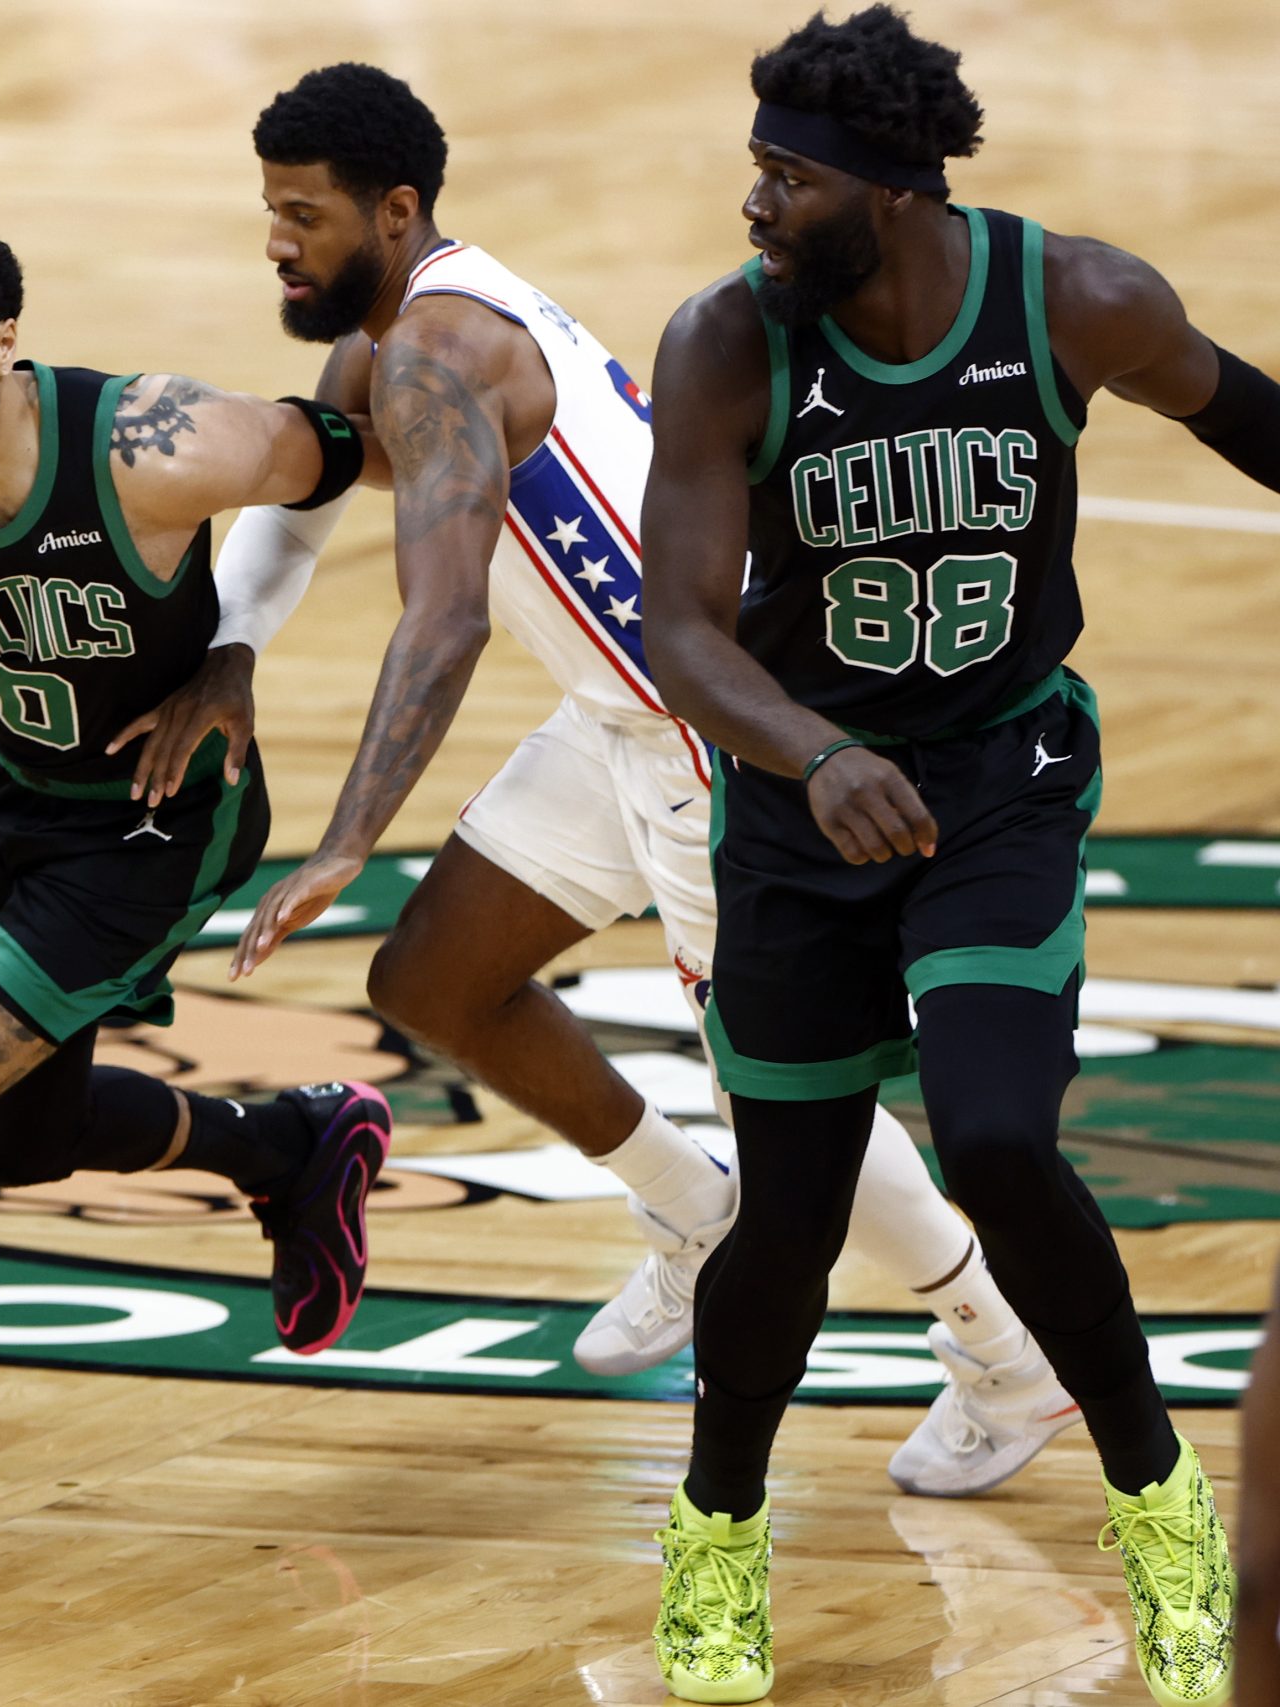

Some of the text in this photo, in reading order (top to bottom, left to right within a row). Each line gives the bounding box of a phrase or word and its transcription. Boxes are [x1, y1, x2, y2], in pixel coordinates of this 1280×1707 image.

[959, 361, 1027, 386] Amica
[790, 427, 1038, 547] CELTICS
[38, 529, 102, 554] Amica
[822, 551, 1018, 677] 88
